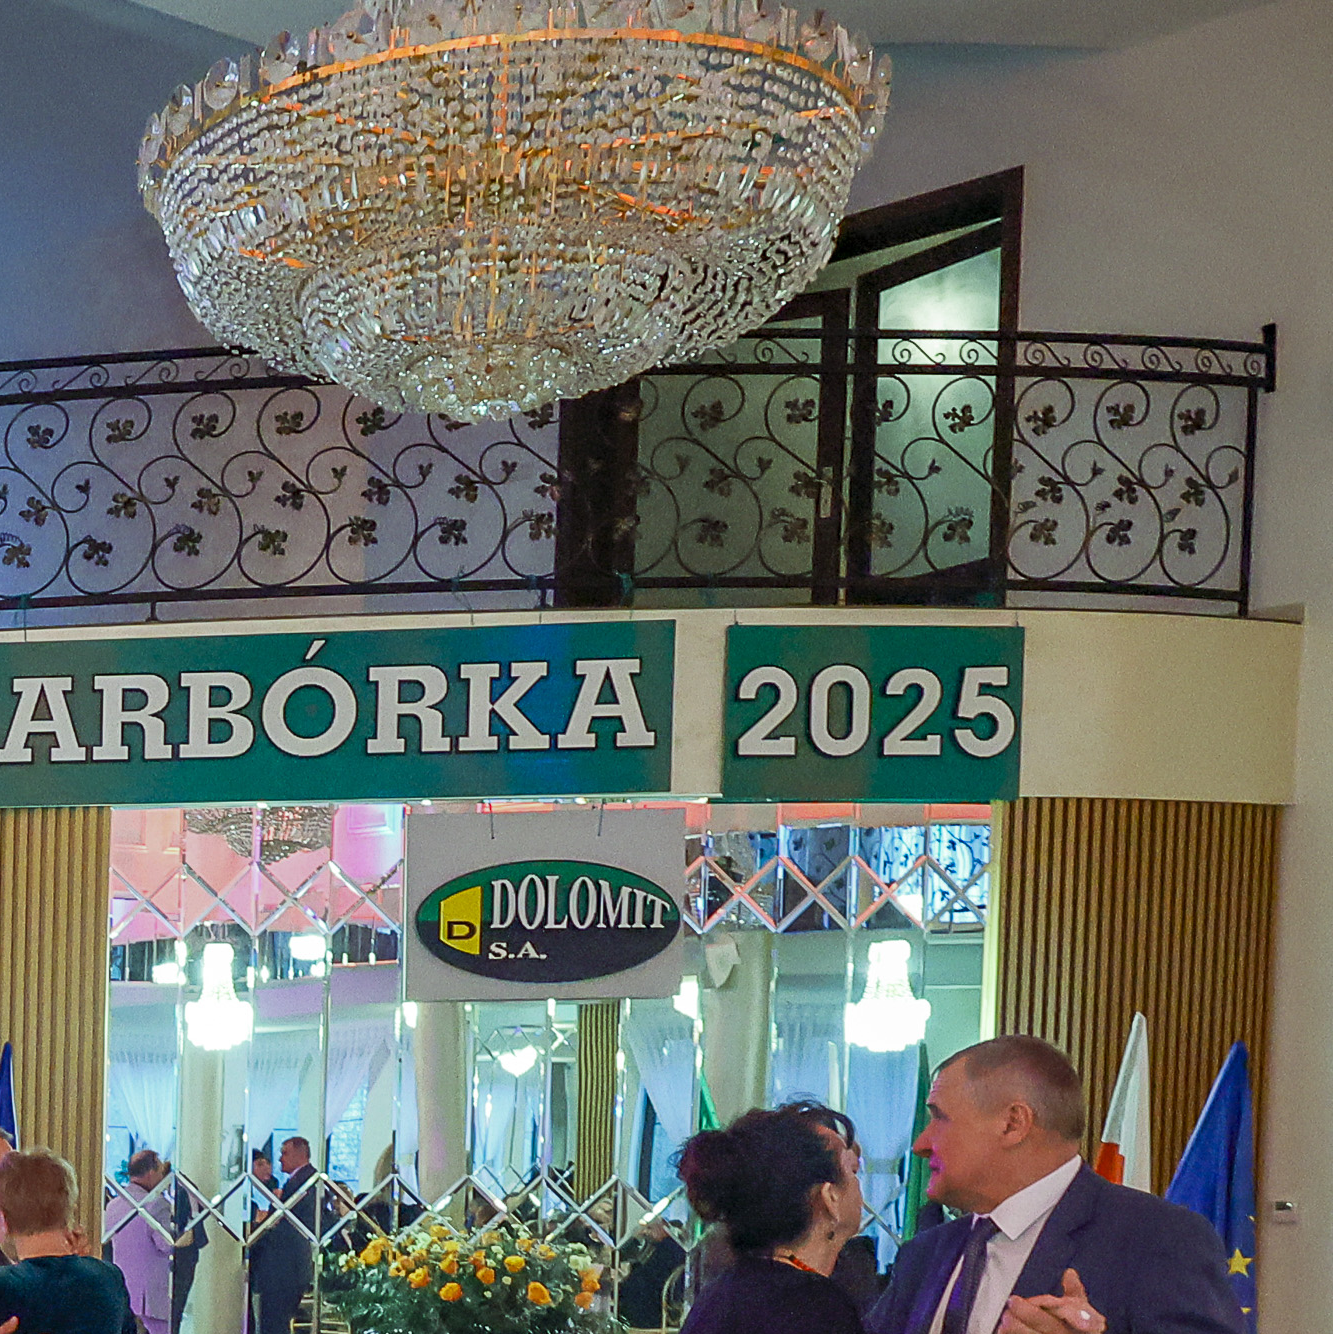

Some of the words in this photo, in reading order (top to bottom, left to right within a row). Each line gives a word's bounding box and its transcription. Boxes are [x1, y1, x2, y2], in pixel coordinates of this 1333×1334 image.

[736, 663, 1018, 758] 2025
[489, 873, 671, 931] DOLOMIT
[445, 920, 478, 941] D
[487, 940, 548, 961] S.A.
